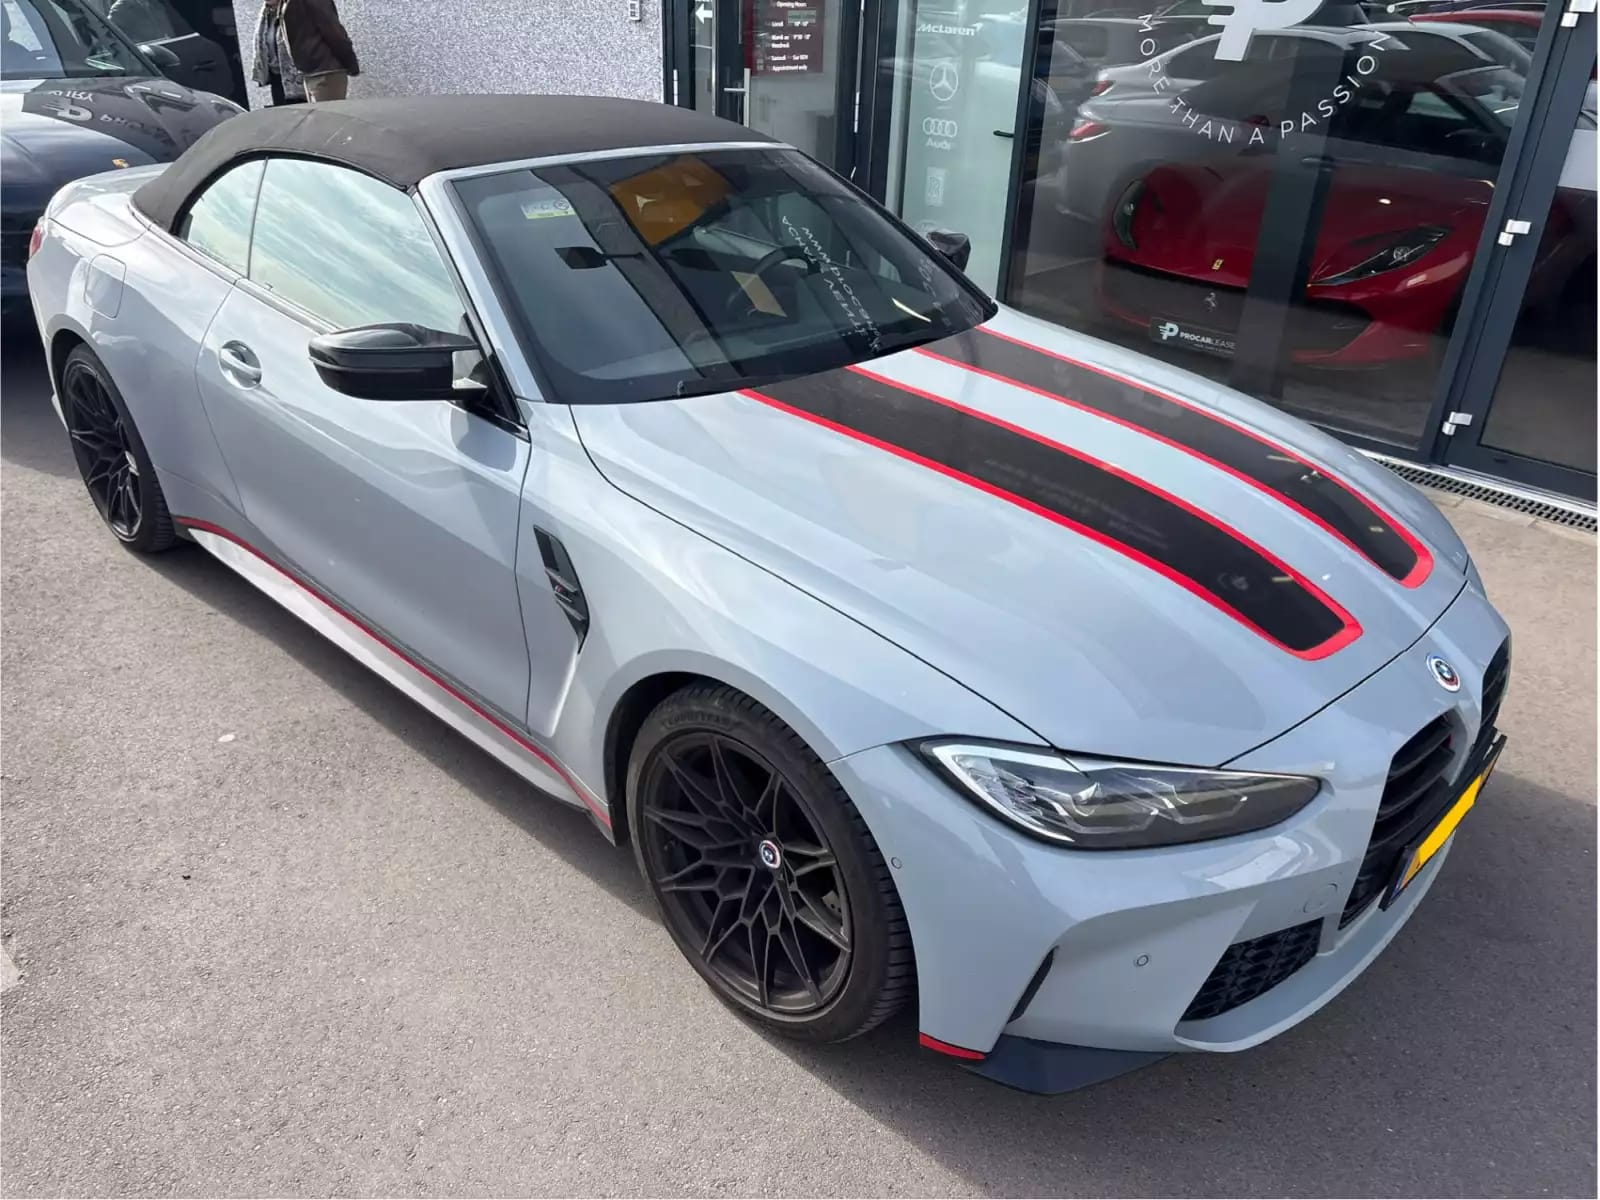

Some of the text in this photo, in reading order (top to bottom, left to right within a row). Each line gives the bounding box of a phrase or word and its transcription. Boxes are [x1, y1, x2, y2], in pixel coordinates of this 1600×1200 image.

[918, 23, 977, 36] McLaren
[1138, 14, 1391, 145] MORE THAN A PASSION
[925, 137, 953, 150] Audi
